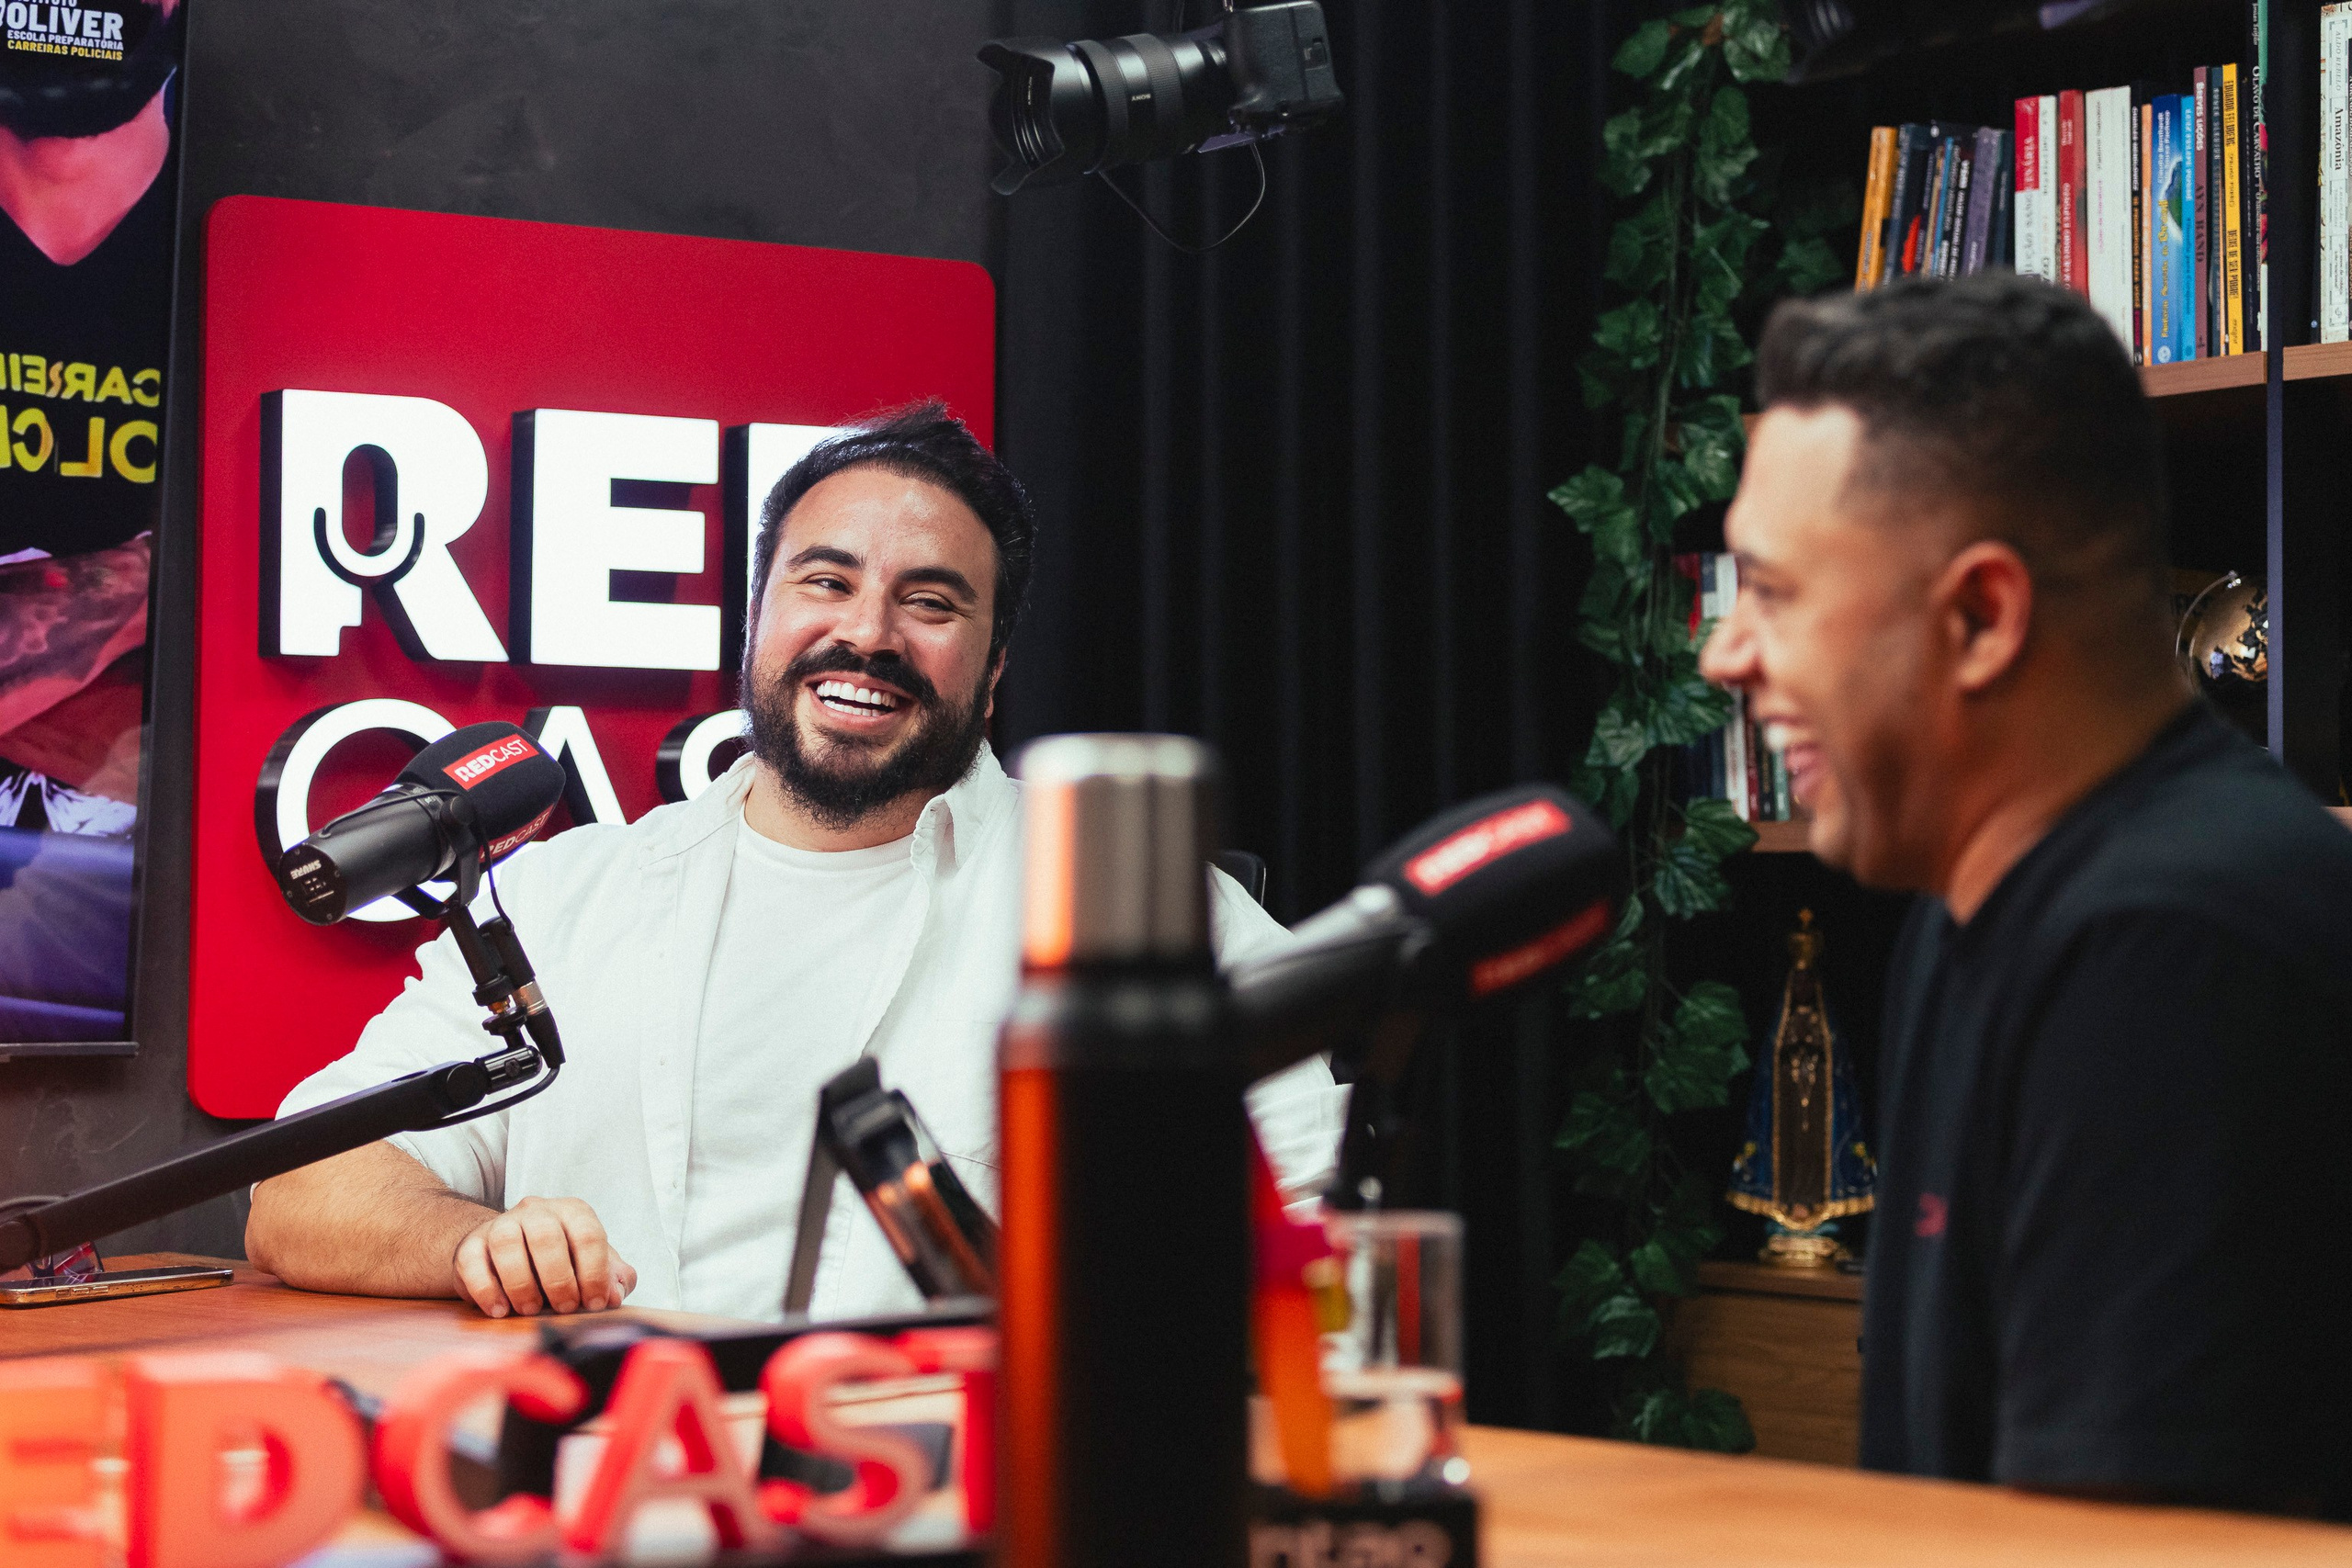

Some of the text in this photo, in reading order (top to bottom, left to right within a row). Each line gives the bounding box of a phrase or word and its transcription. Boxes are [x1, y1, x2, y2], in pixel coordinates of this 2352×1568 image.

[6, 29, 124, 51] ESCOLA PREPARATÓRIA
[7, 39, 123, 61] CARREIRAS POLICIAIS
[1131, 93, 1151, 102] SONY
[2252, 65, 2260, 104] OLAVO
[2195, 81, 2204, 152] BREVES LIÇÕES
[2253, 121, 2262, 178] CARVALHO
[2335, 107, 2345, 171] Amazônia
[454, 739, 528, 783] REDCAST
[290, 859, 322, 880] SHURE
